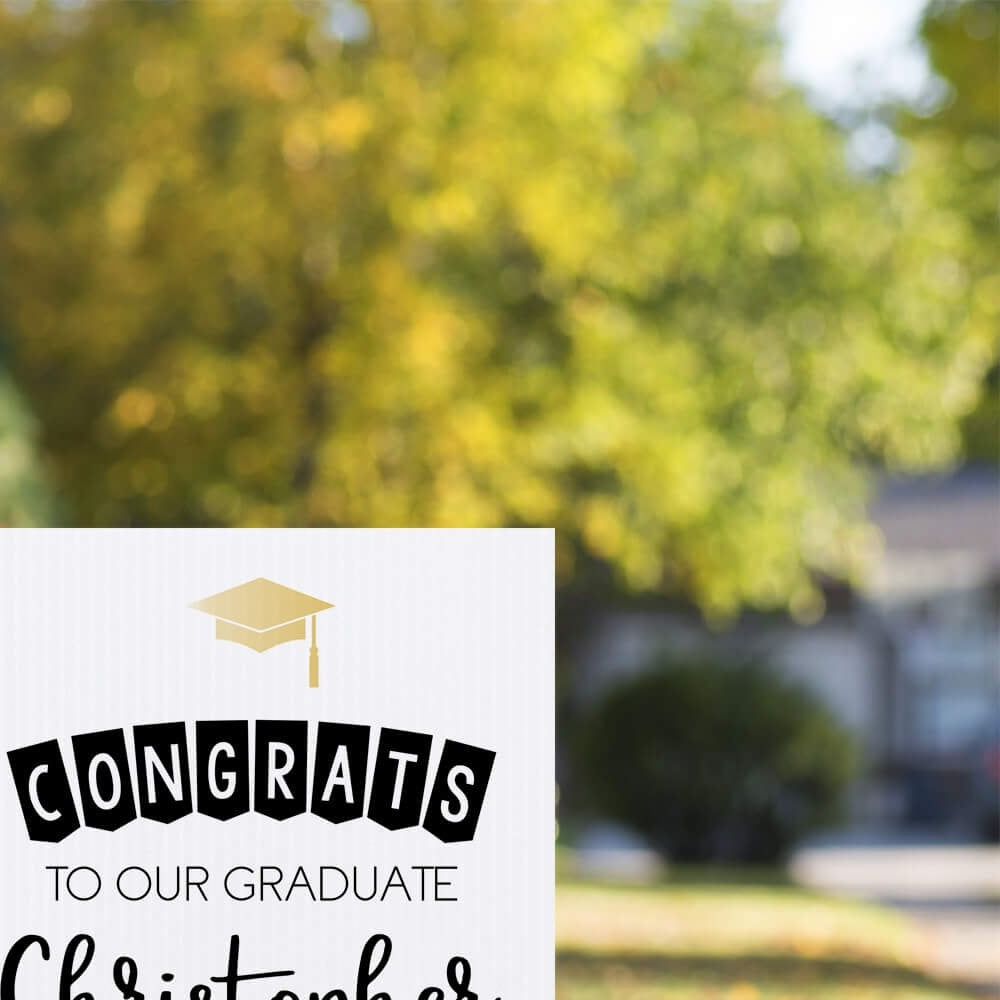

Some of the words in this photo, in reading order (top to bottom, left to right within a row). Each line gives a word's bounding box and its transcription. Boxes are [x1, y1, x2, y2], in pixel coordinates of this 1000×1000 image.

[28, 741, 475, 823] CONGRATS
[46, 866, 101, 901] TO
[117, 866, 209, 901] OUR
[224, 866, 457, 901] GRADUATE
